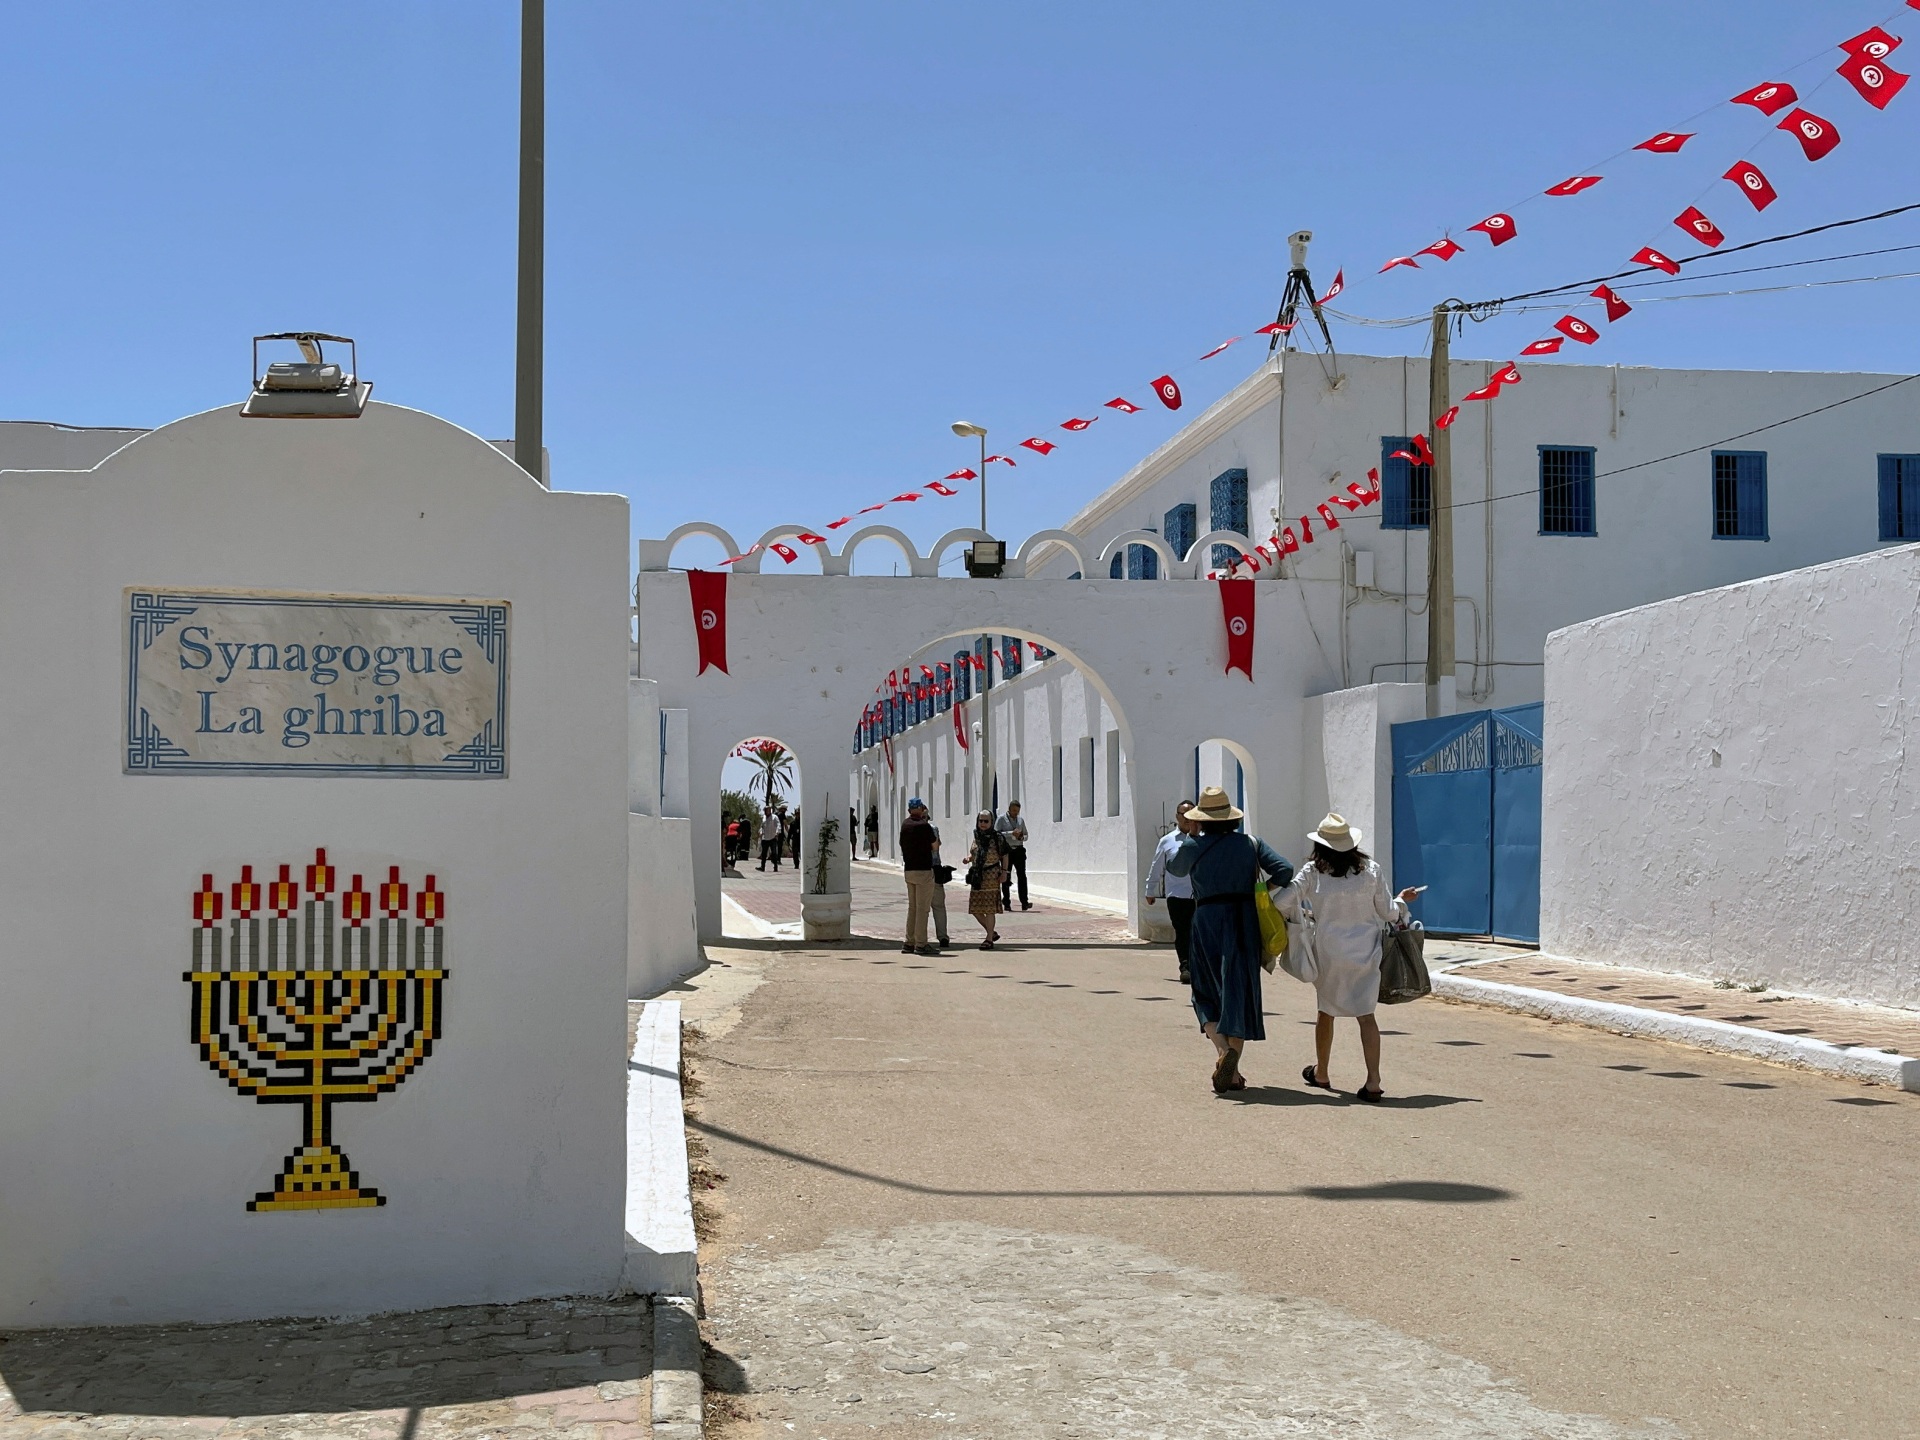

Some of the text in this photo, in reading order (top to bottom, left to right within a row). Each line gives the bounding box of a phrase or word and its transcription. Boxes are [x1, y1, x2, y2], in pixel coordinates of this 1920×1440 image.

[178, 626, 464, 686] Synagogue
[195, 690, 447, 748] La ghriba
